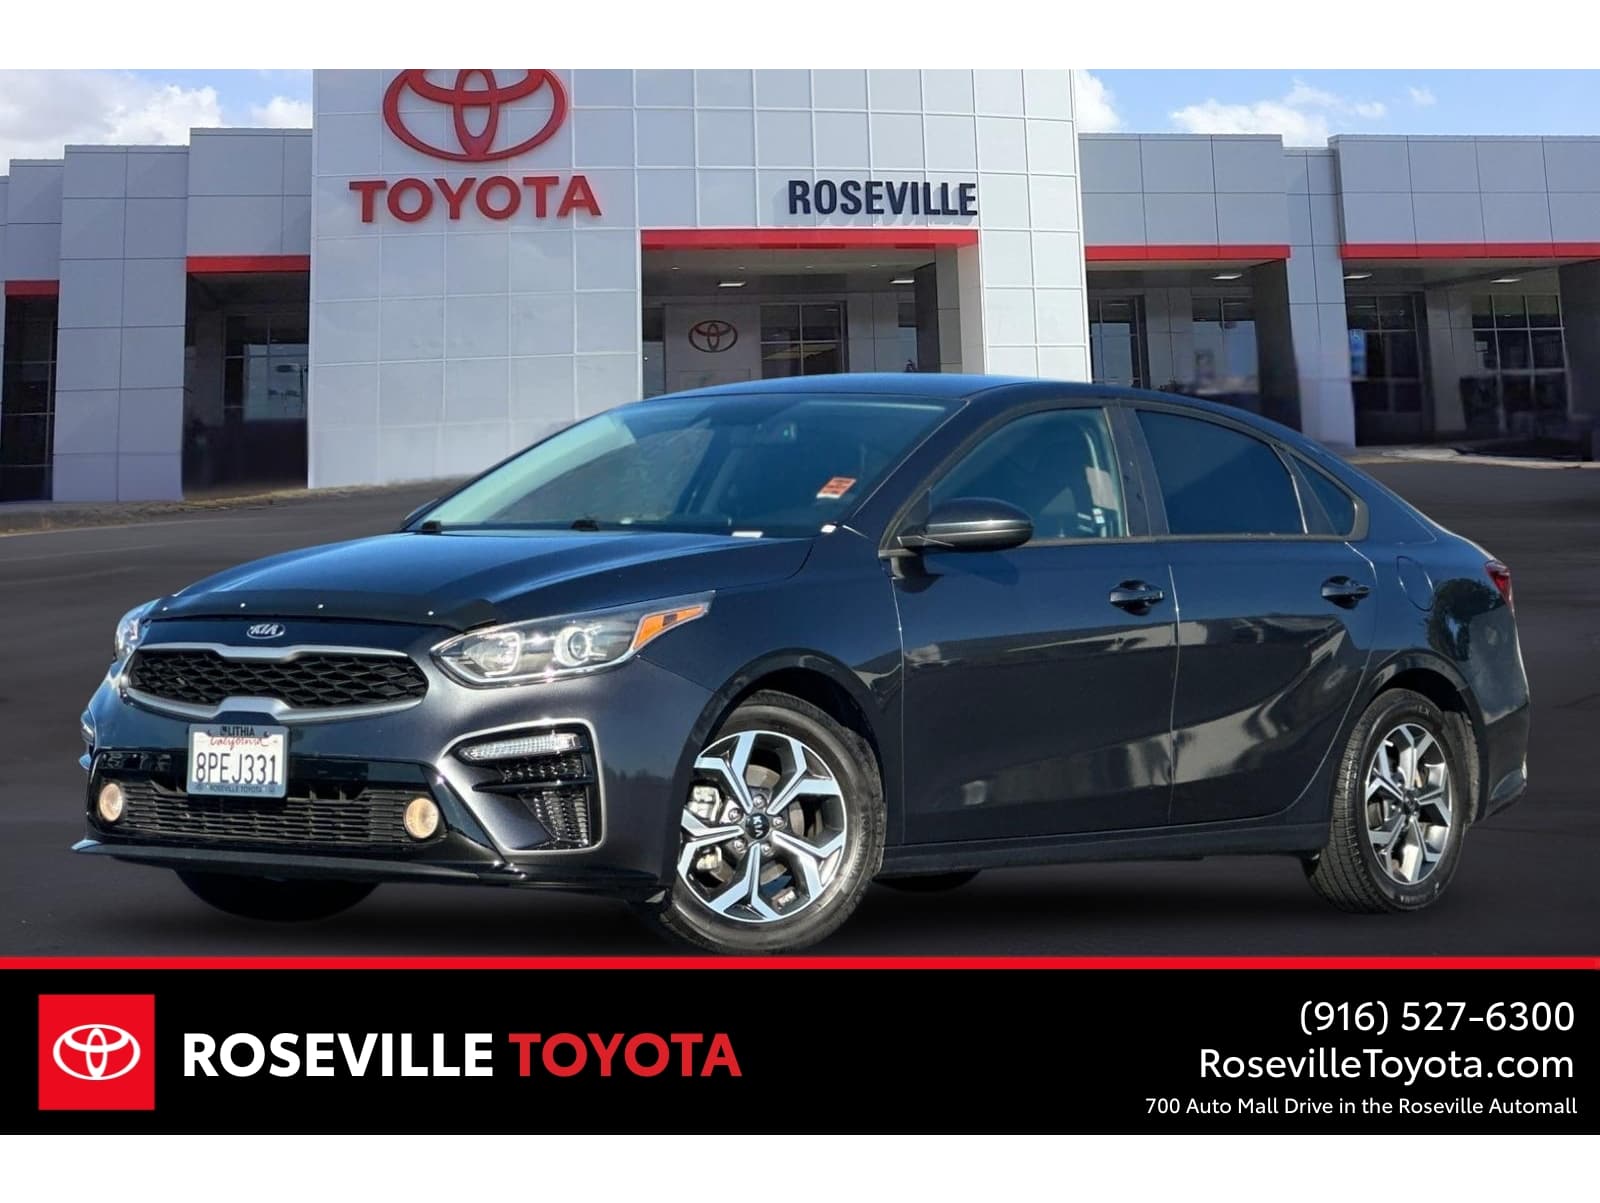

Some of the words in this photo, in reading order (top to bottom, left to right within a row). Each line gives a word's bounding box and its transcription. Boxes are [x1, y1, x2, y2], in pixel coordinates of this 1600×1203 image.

[349, 175, 602, 223] TOYOTA
[788, 179, 978, 216] ROSEVILLE
[250, 624, 279, 634] KIA
[228, 726, 255, 737] LITHIA
[210, 737, 268, 750] California
[196, 752, 278, 785] 8PEJ331
[210, 784, 239, 793] ROSEVILLE
[240, 785, 262, 793] TOYOTA
[752, 815, 763, 838] KIA
